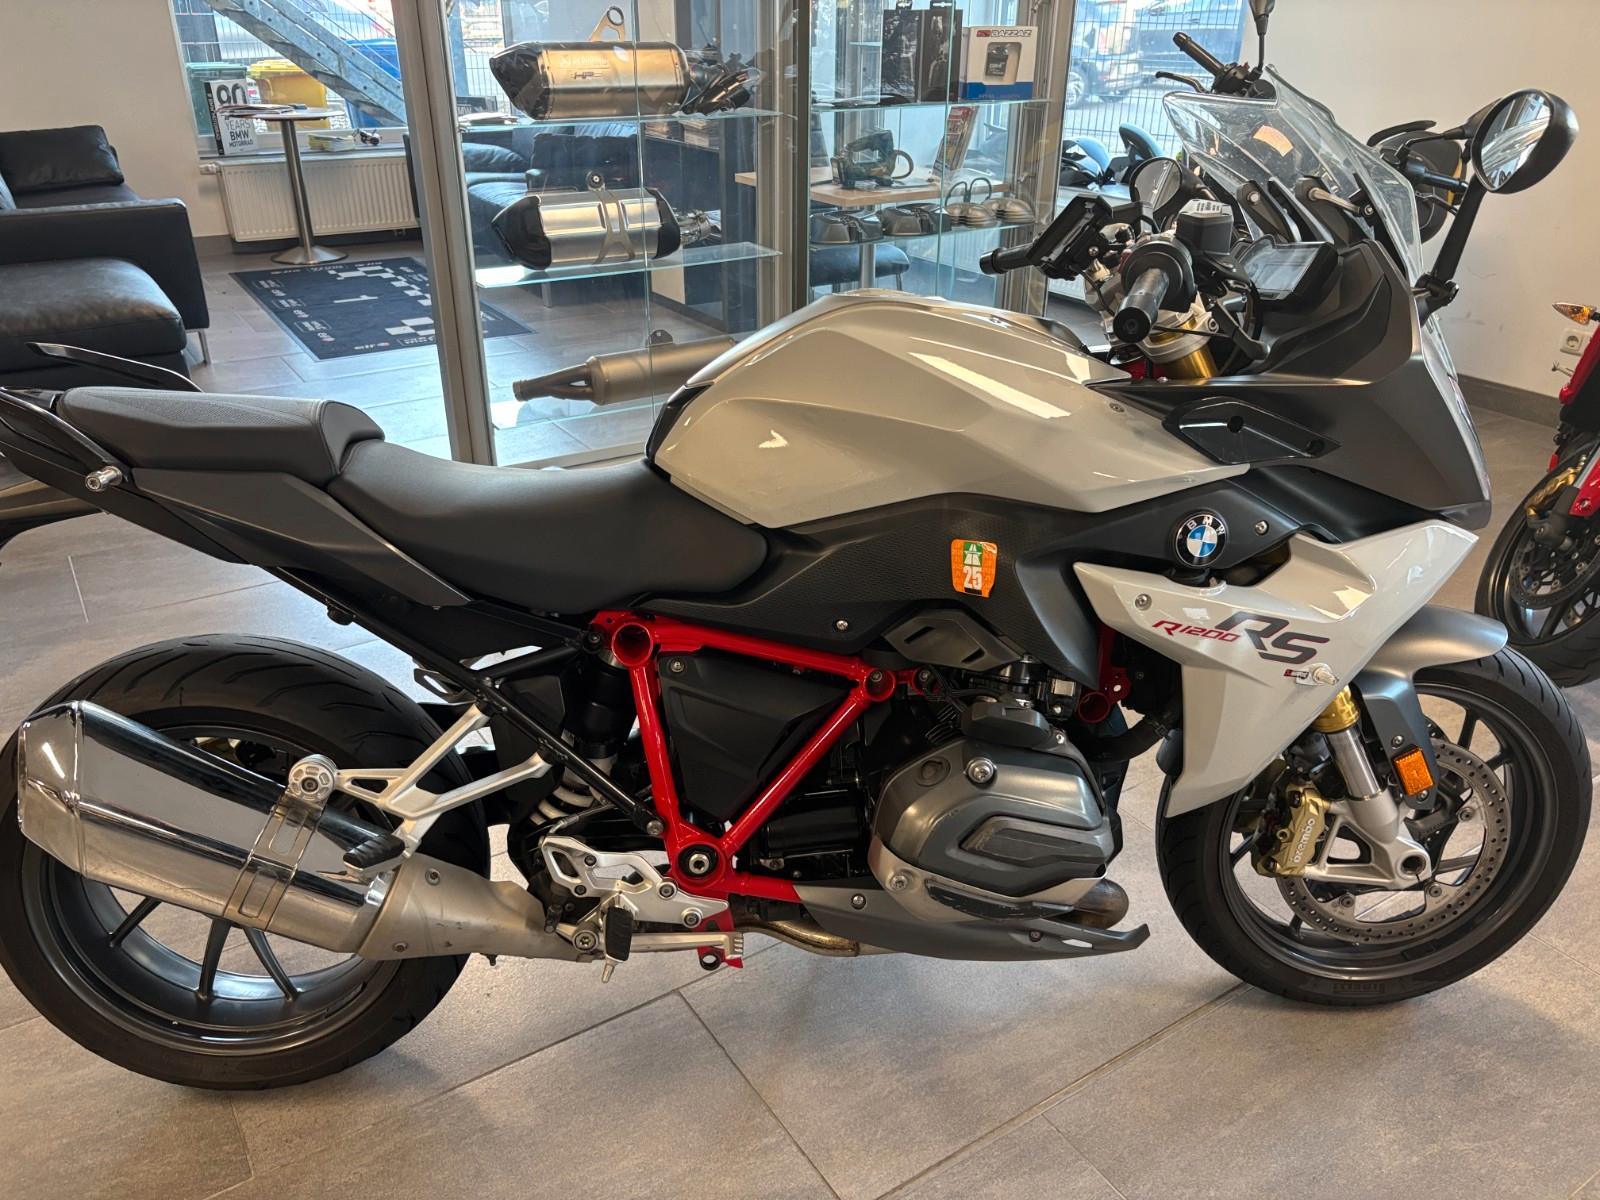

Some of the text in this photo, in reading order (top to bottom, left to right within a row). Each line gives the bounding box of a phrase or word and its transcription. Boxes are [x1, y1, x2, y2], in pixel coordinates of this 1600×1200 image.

[225, 119, 251, 130] YEARS
[229, 130, 249, 140] BMW
[1187, 514, 1226, 536] BMW
[962, 565, 983, 591] 25
[1215, 611, 1331, 665] RS
[1294, 817, 1316, 863] brembo
